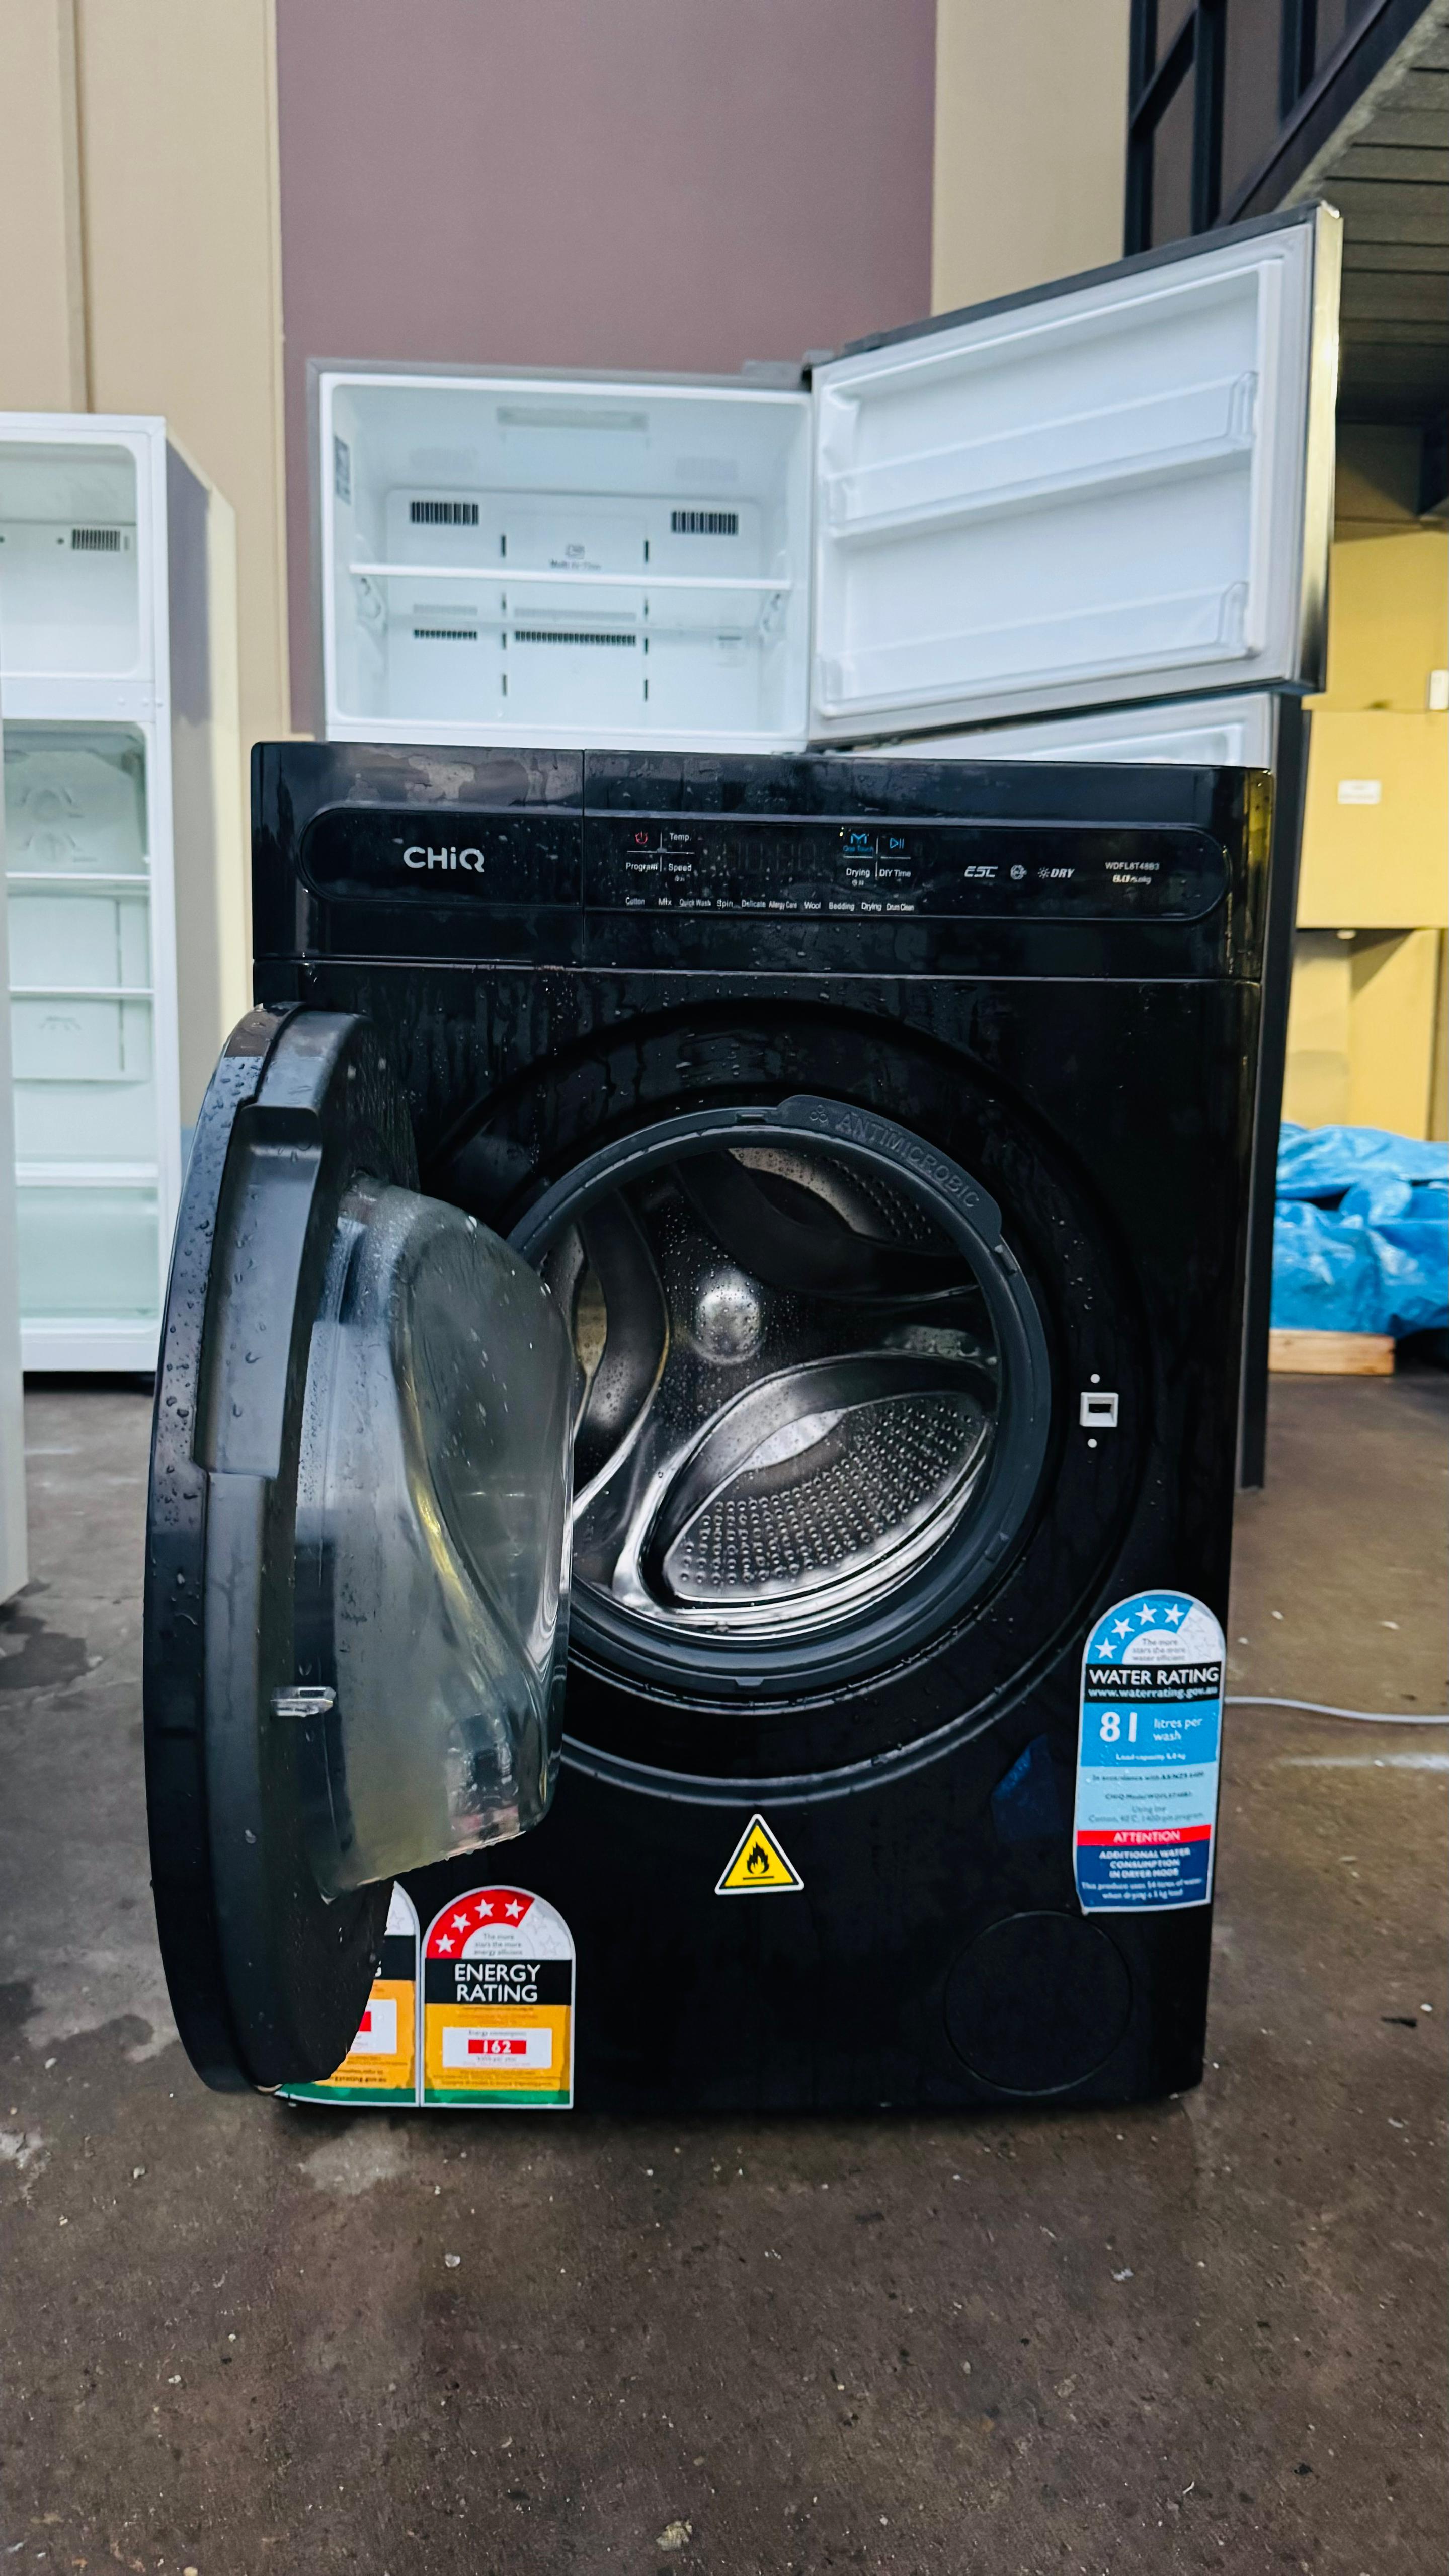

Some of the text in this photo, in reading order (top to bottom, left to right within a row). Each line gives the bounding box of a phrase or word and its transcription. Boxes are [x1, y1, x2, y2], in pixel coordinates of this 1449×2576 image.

[403, 846, 485, 873] CHiQ
[625, 862, 658, 872] Program
[668, 863, 692, 872] Speed
[846, 867, 871, 878] Drying
[894, 869, 911, 877] Time
[1050, 867, 1075, 878] DRY
[625, 897, 645, 906] Cotton
[658, 898, 672, 906] Mix
[679, 898, 695, 907] Quick
[716, 899, 733, 908] Spin
[741, 899, 766, 908] Delicate
[786, 901, 797, 909] Care
[804, 901, 821, 909] Wool
[829, 902, 855, 911] Bedding
[861, 902, 882, 911] Drying
[900, 903, 915, 911] Clean
[1089, 1666, 1220, 1685] WATER RATING
[1088, 1685, 1218, 1699] www.waterrating.gov.au
[1154, 1717, 1203, 1730] litres per
[1153, 1730, 1182, 1742] wash
[1112, 1830, 1181, 1844] ATTENTION
[1098, 1847, 1191, 1860] ADDITIONAL WATER
[1109, 1859, 1181, 1869] CONSUMPTION
[454, 1963, 541, 1983] ENERGY
[456, 1984, 538, 2003] RATING
[482, 2040, 512, 2054] 162
